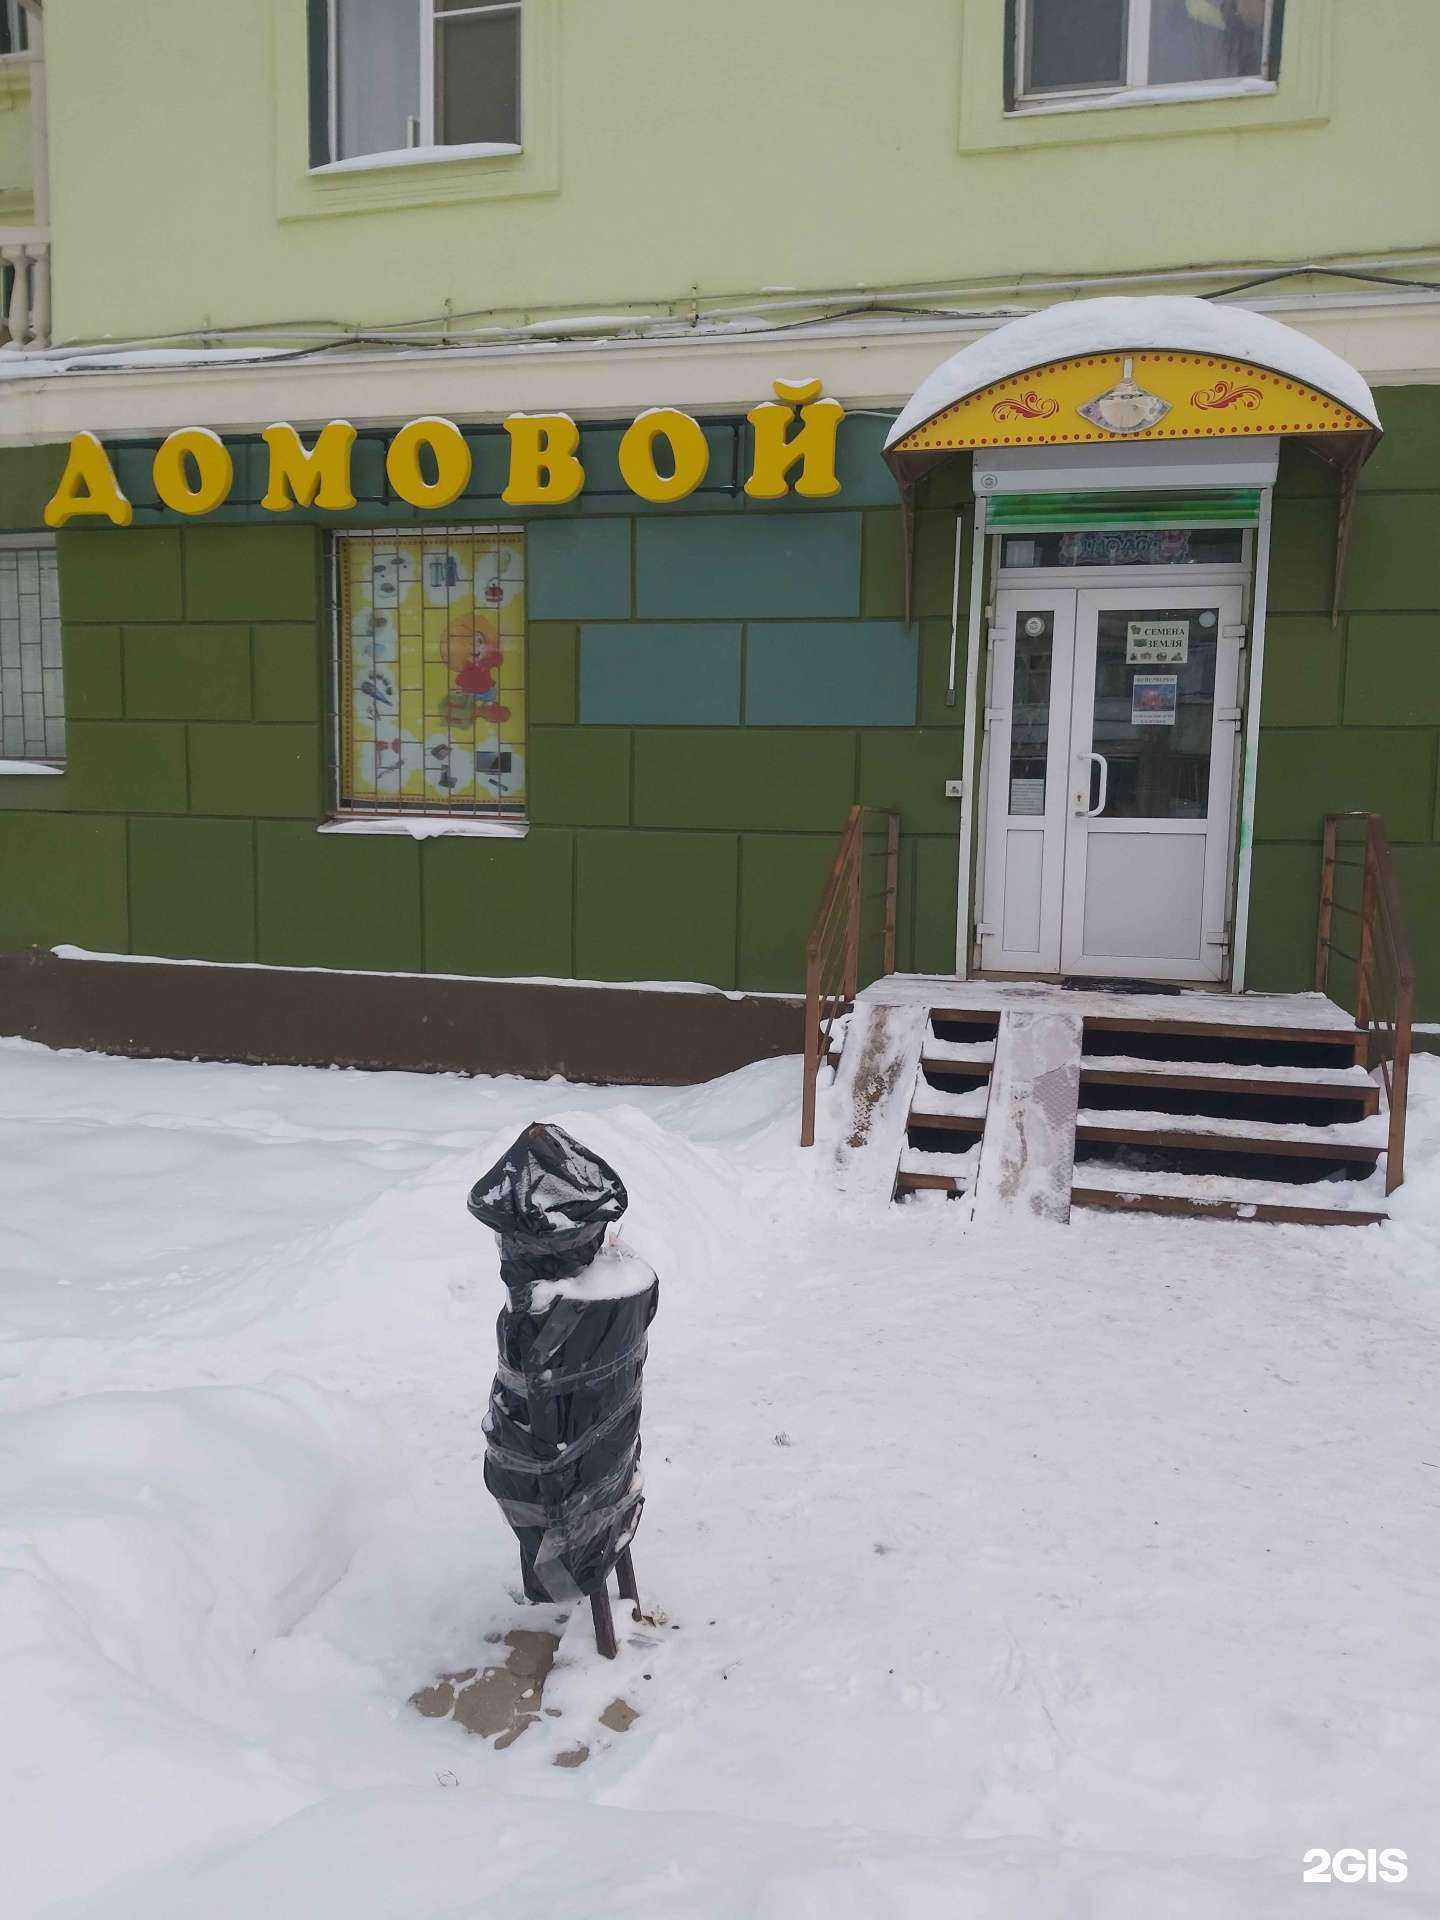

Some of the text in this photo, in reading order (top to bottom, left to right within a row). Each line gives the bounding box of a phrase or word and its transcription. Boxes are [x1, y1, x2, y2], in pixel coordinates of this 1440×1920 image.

[44, 377, 845, 528] ДОМОВОЙ
[1144, 627, 1185, 636] СЕМЕНА
[1147, 639, 1182, 648] ЗЕМЛЯ
